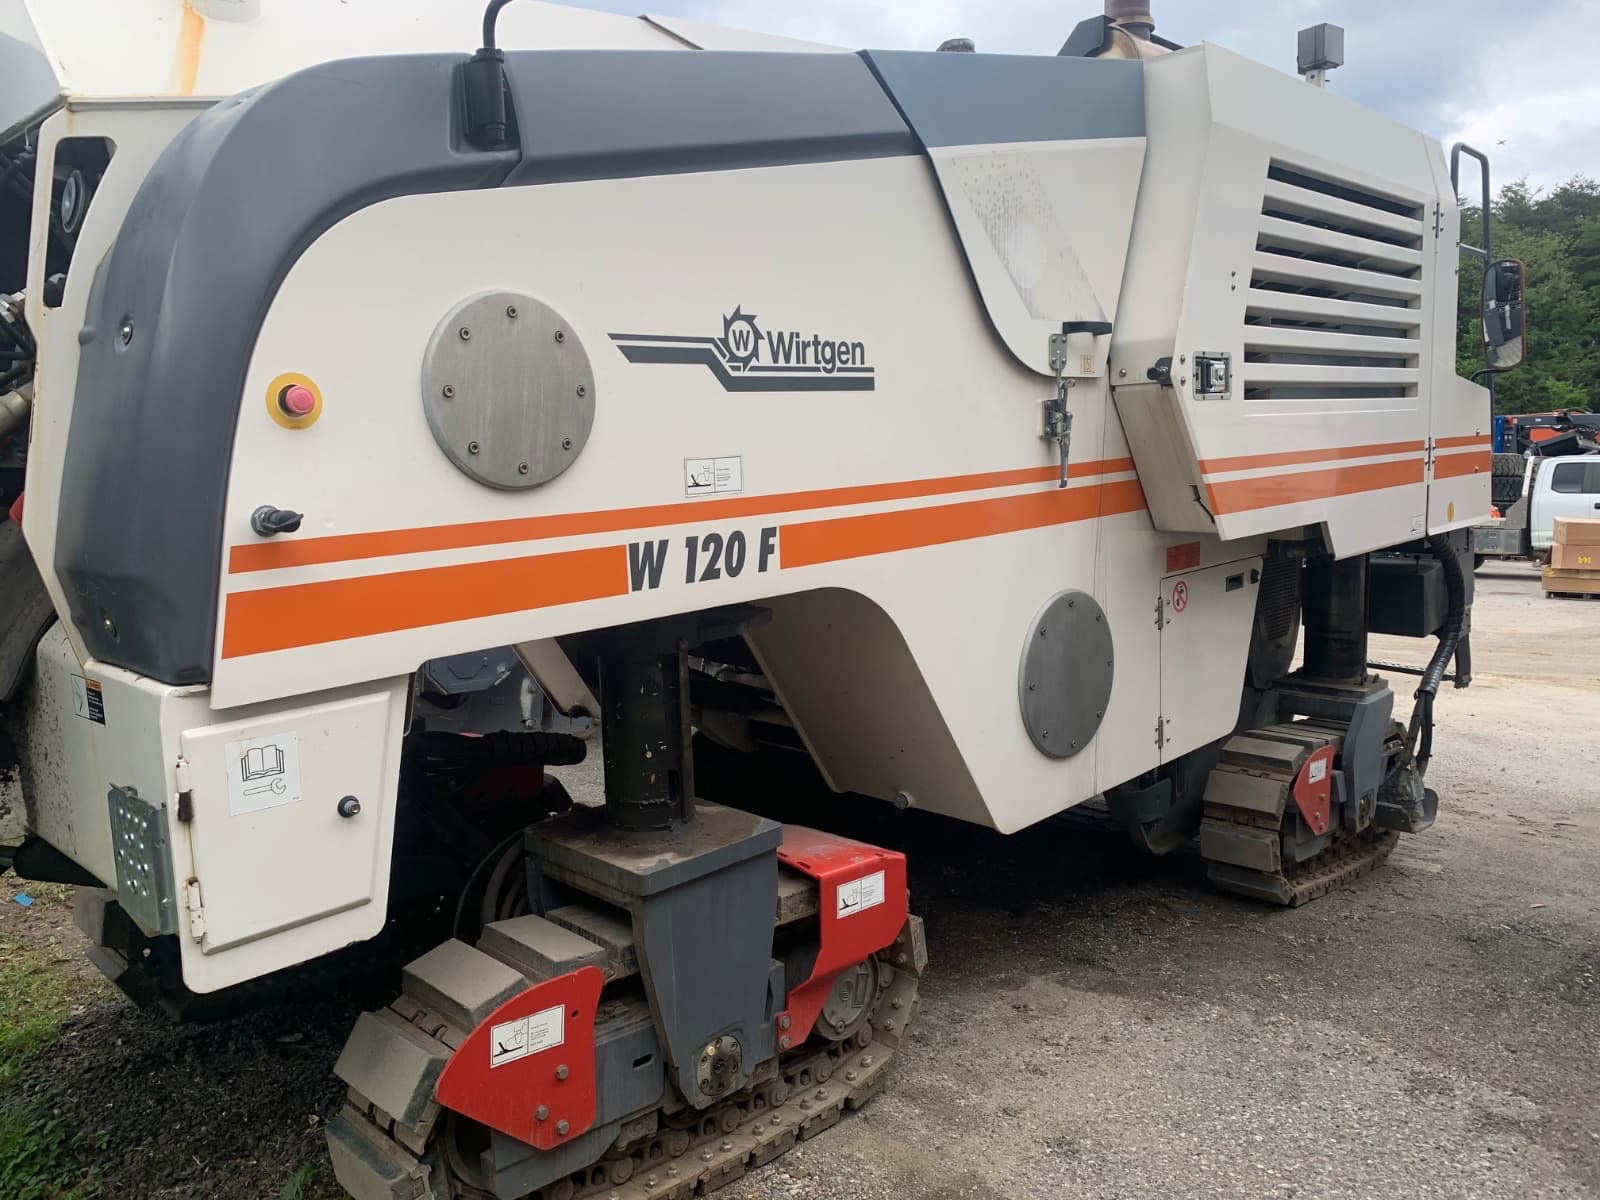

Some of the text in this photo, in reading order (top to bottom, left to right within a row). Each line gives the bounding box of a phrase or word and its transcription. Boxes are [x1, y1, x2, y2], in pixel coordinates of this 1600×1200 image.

[732, 330, 865, 374] W Wirtgen
[628, 526, 777, 591] W 120 F
